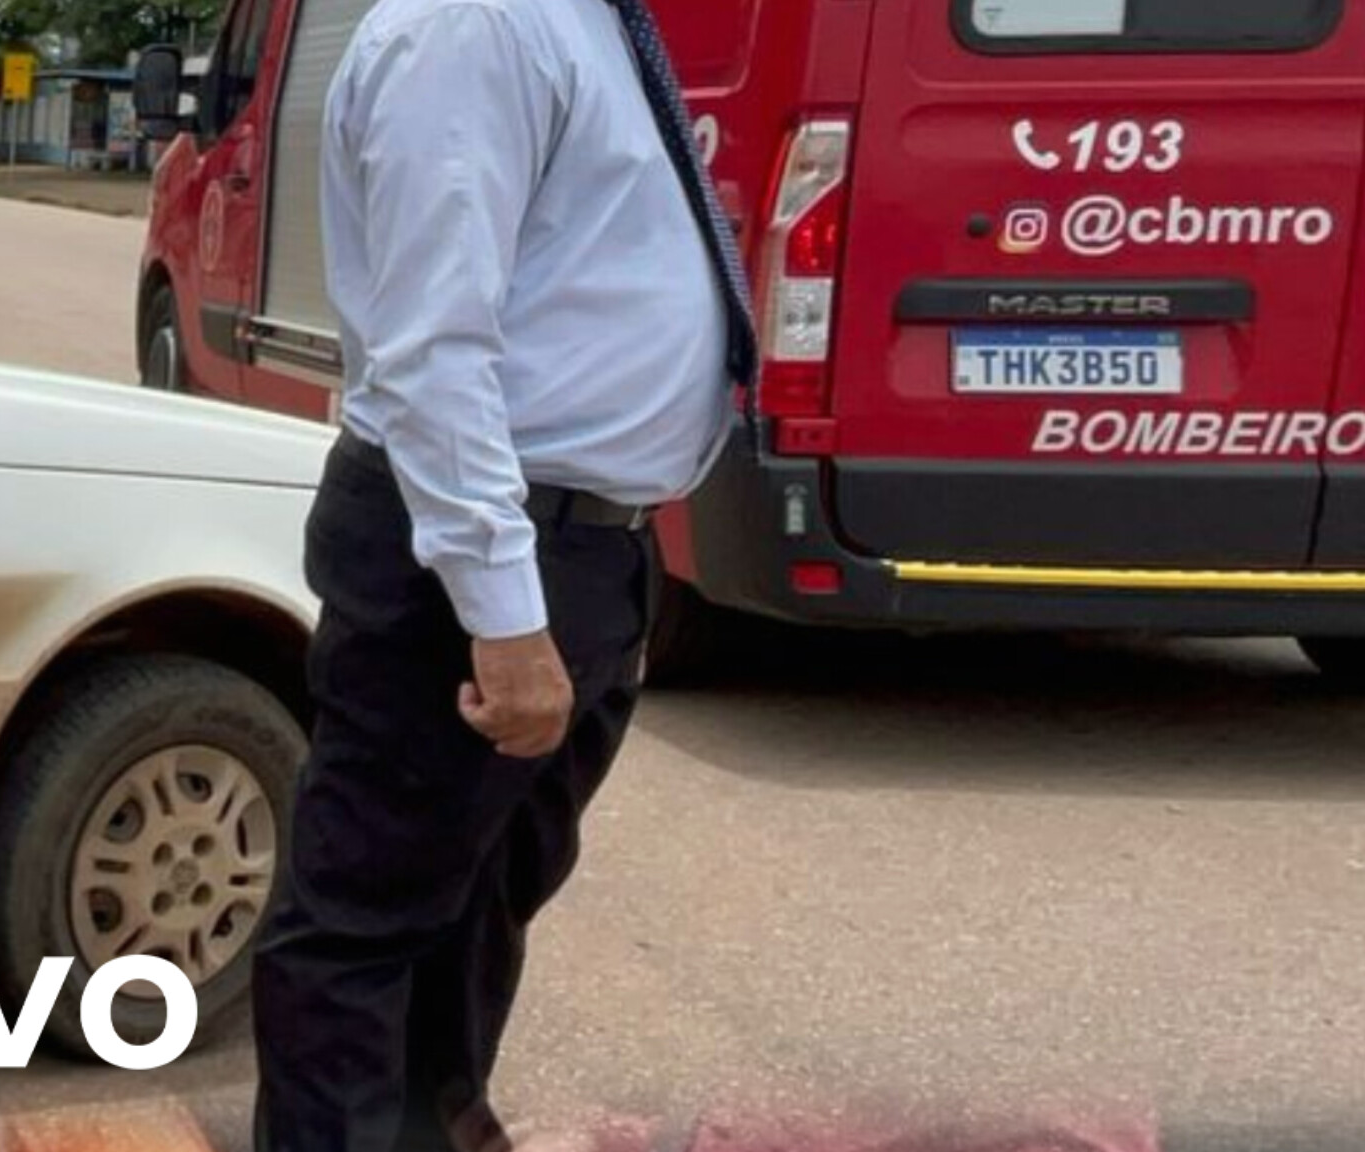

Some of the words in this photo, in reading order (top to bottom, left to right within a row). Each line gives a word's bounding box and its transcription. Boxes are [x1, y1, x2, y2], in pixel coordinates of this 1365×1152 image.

[1067, 120, 1184, 172] 193
[1061, 195, 1333, 256] @cbmro
[988, 295, 1170, 315] MASTER
[977, 349, 1158, 386] THK3B50
[1031, 409, 1365, 455] BOMBEIRO
